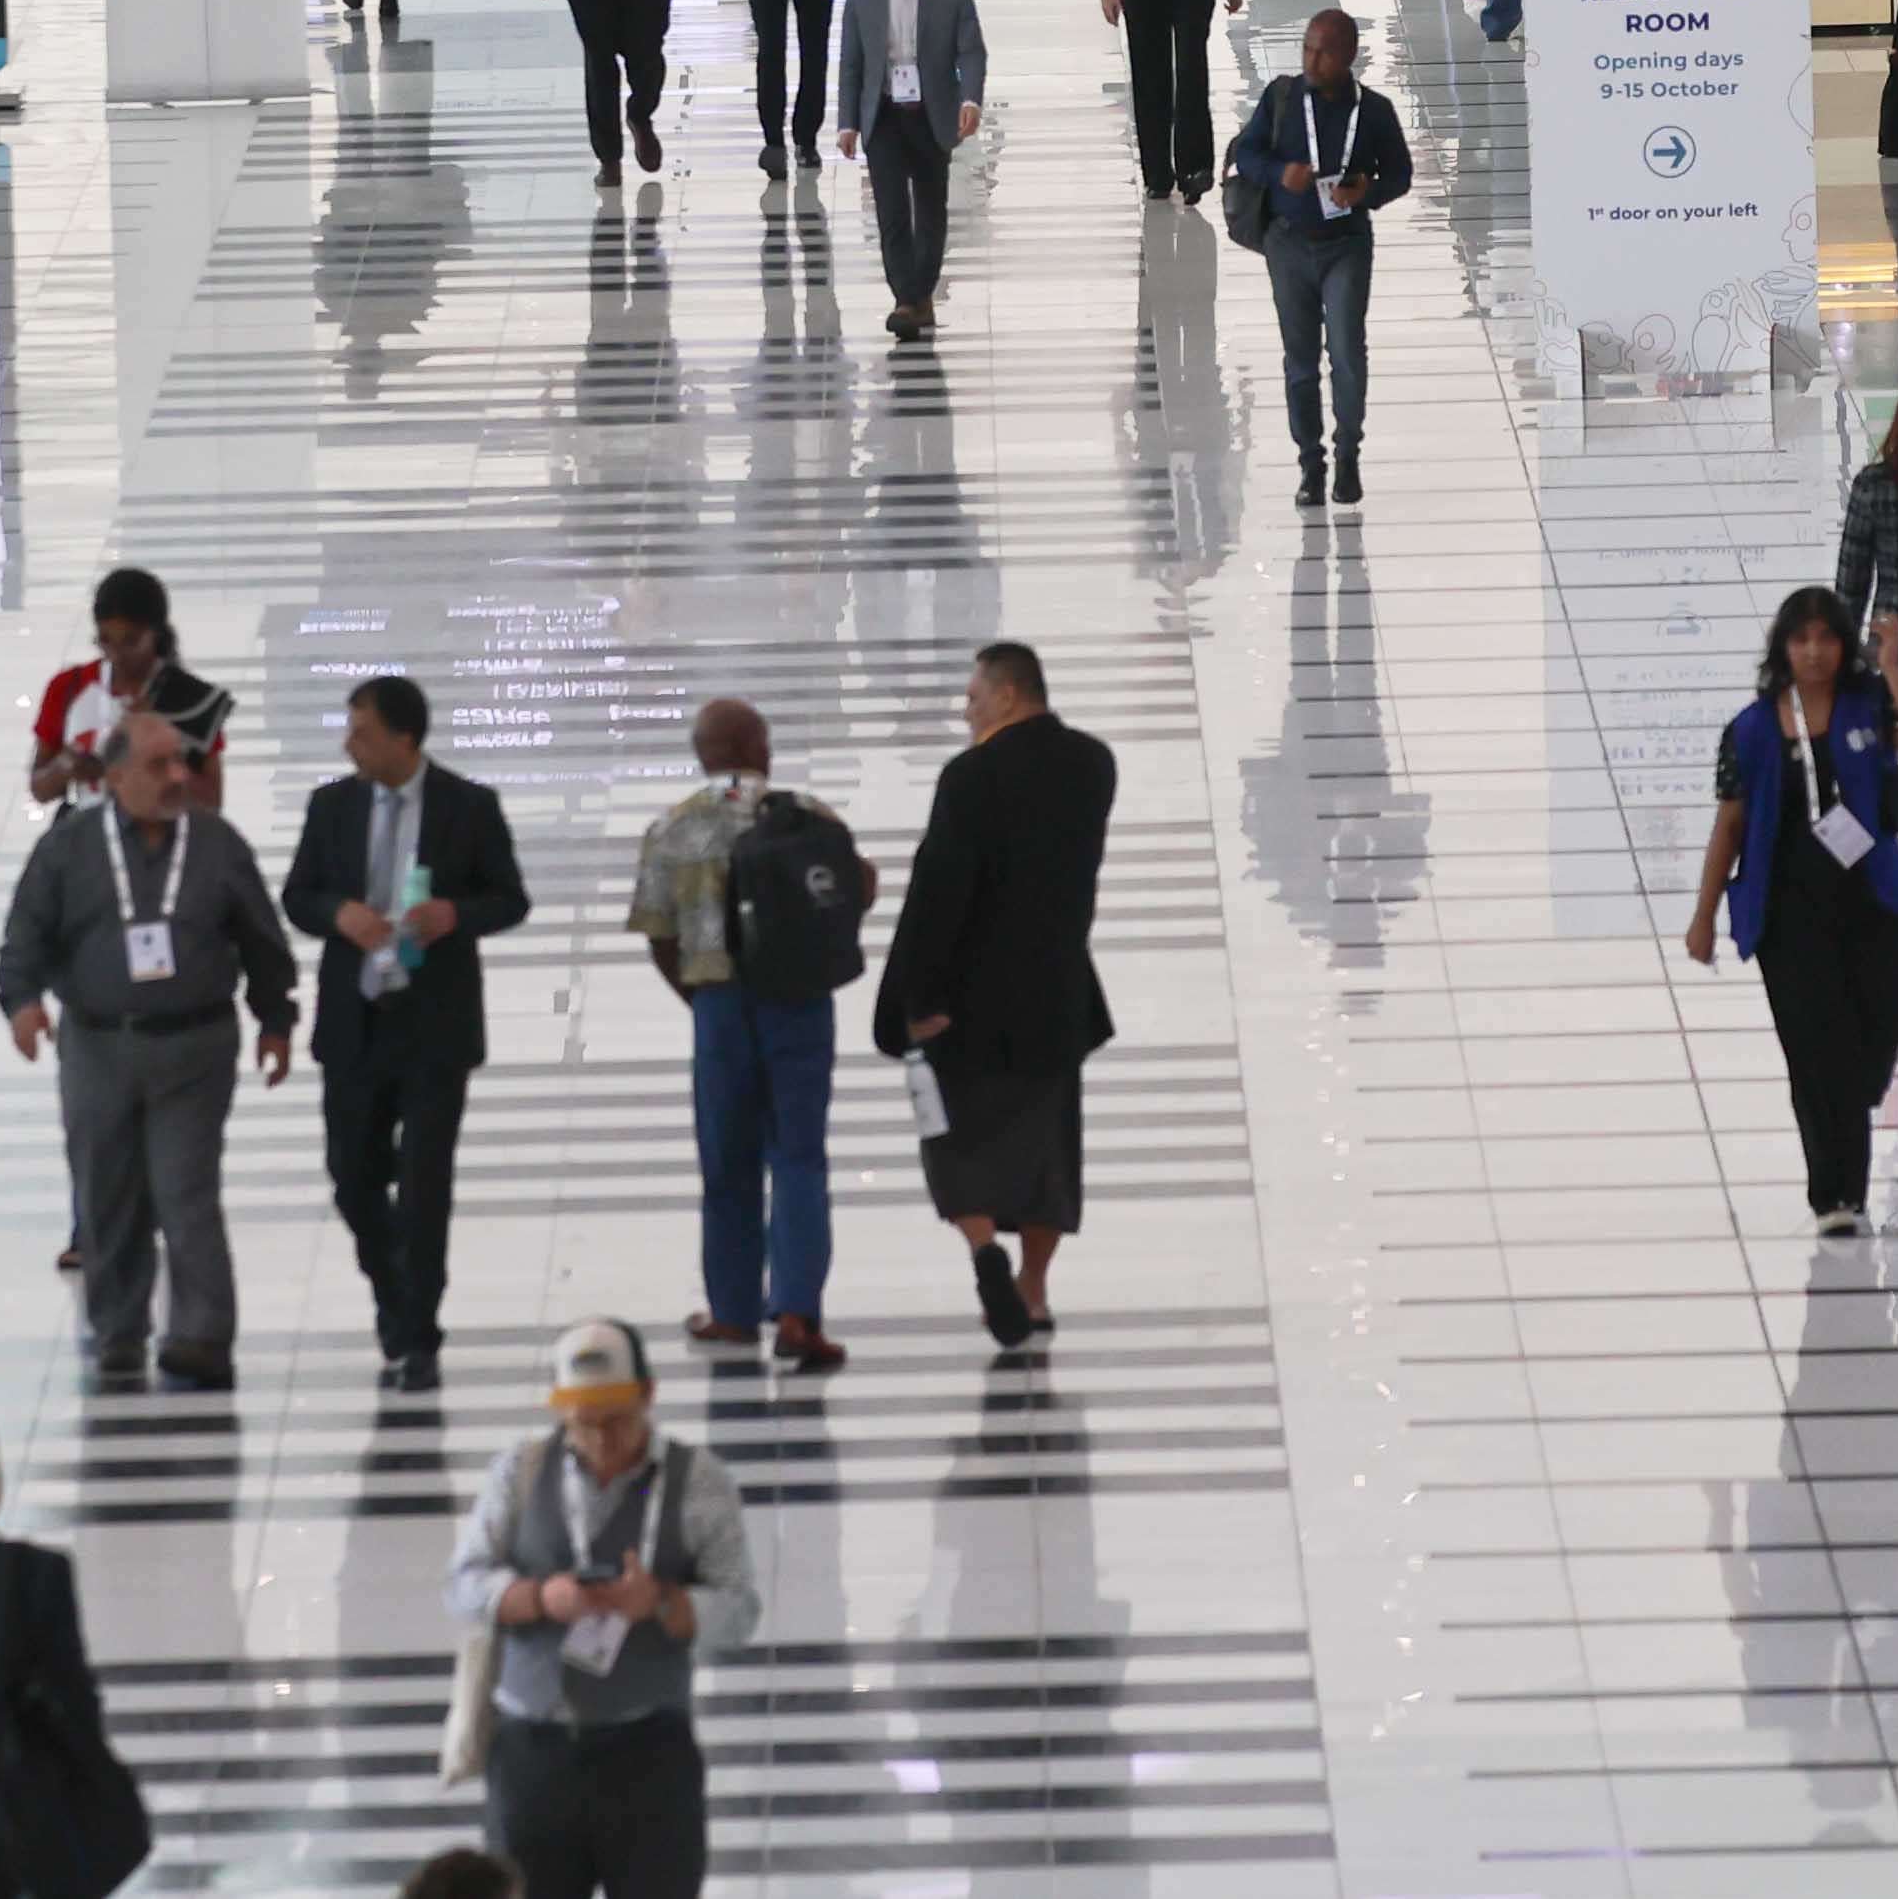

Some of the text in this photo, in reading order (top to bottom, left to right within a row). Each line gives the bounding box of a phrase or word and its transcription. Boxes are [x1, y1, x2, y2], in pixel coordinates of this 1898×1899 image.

[1625, 12, 1710, 33] ROOM
[1594, 51, 1744, 72] Opening days
[1600, 80, 1739, 99] 9-15 October
[1588, 203, 1758, 222] 1st door on your left
